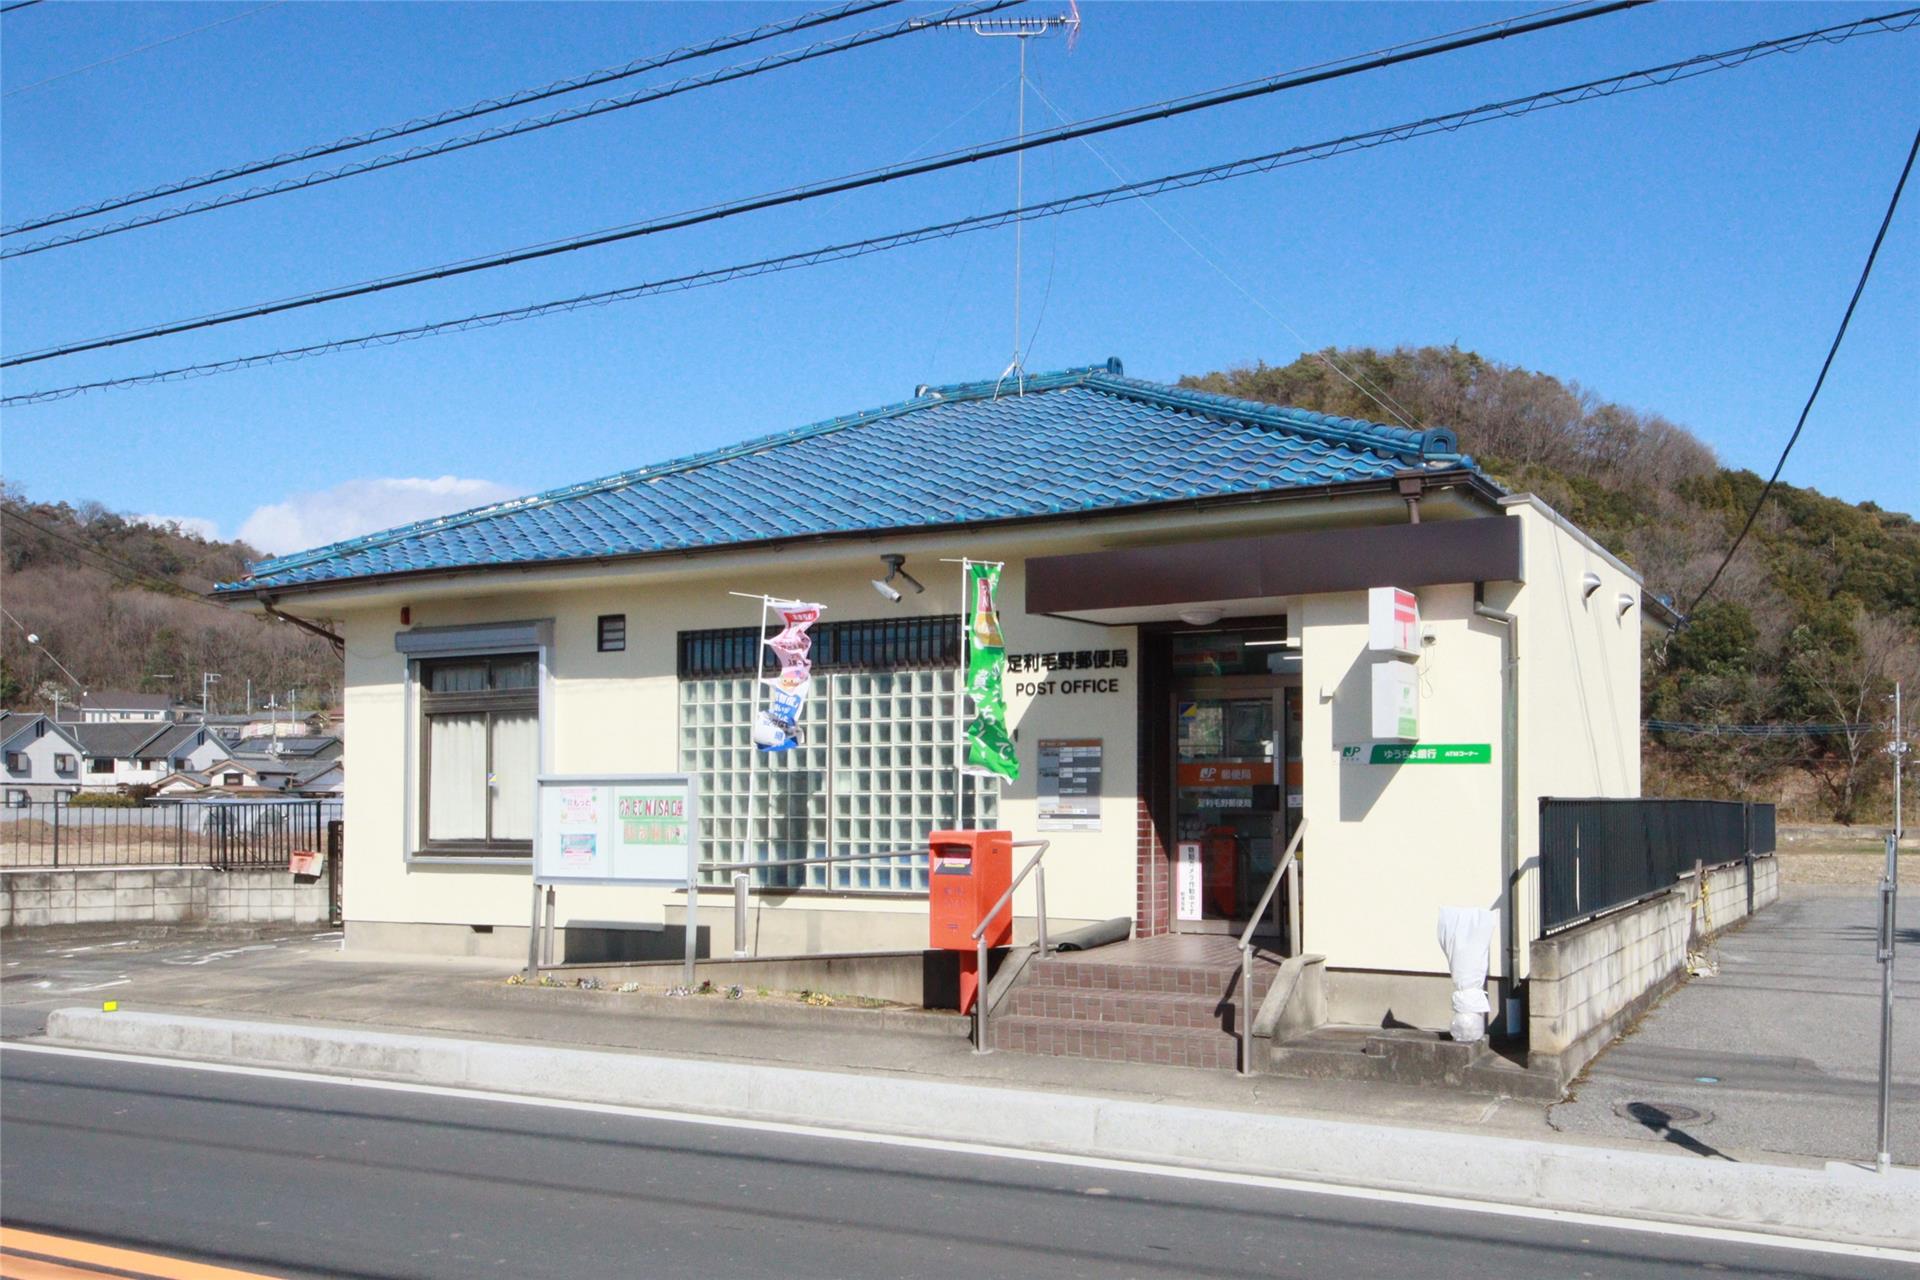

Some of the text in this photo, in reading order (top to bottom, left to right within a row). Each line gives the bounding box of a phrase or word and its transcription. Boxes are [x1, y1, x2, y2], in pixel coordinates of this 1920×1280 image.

[1007, 649, 1128, 673] 足利毛野郵便局
[1016, 679, 1119, 696] POST OFFICE
[1384, 748, 1437, 759] ゆうちょ銀行
